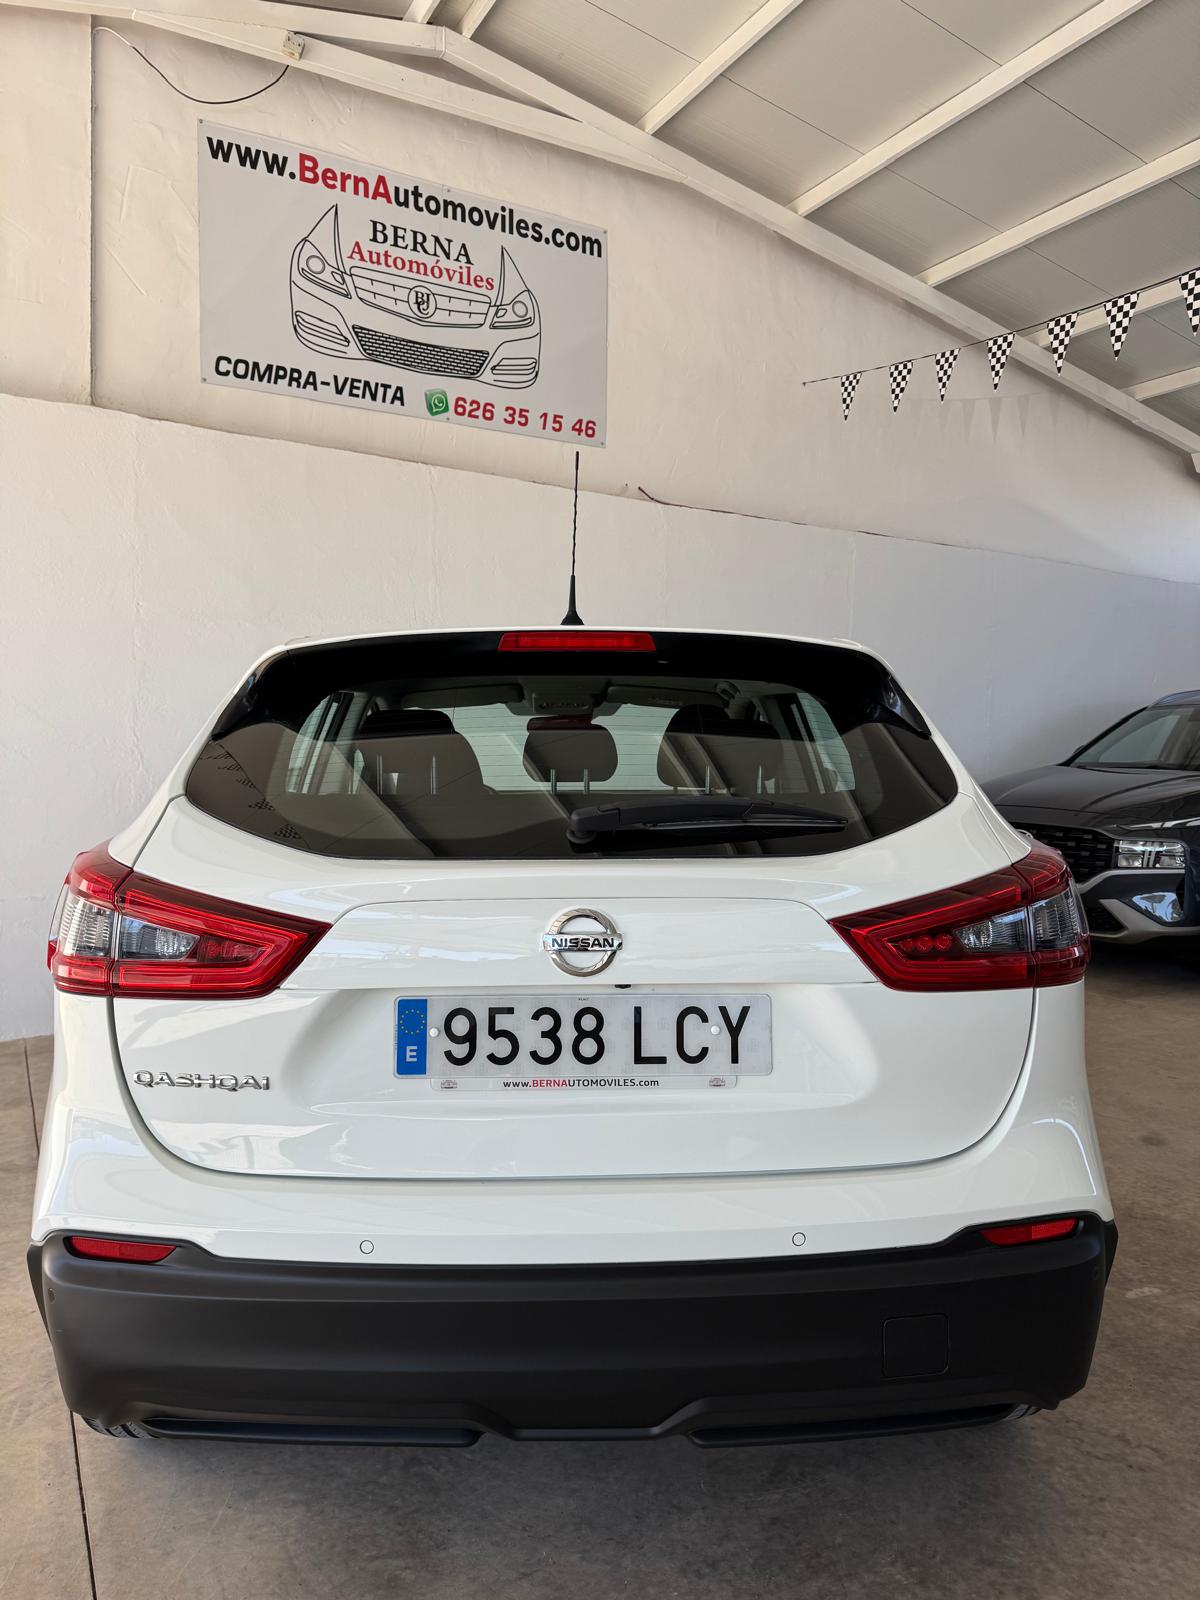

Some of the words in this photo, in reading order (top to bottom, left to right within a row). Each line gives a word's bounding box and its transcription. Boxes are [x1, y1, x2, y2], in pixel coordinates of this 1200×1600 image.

[206, 136, 602, 258] www.BernAutomoviles.com
[369, 219, 474, 265] BERNA
[347, 241, 495, 291] Automóviles
[214, 355, 406, 407] COMPRA-VENTA
[453, 396, 495, 422] 626
[503, 406, 530, 427] 35
[539, 412, 563, 433] 15
[571, 417, 597, 439] 46
[551, 937, 615, 949] NISSAN
[405, 1045, 418, 1062] E
[443, 1006, 606, 1067] 9538
[633, 1005, 751, 1065] LCY
[133, 1069, 270, 1092] QASHQAI
[503, 1078, 660, 1088] www.BERNAUTOMOVILES.com
